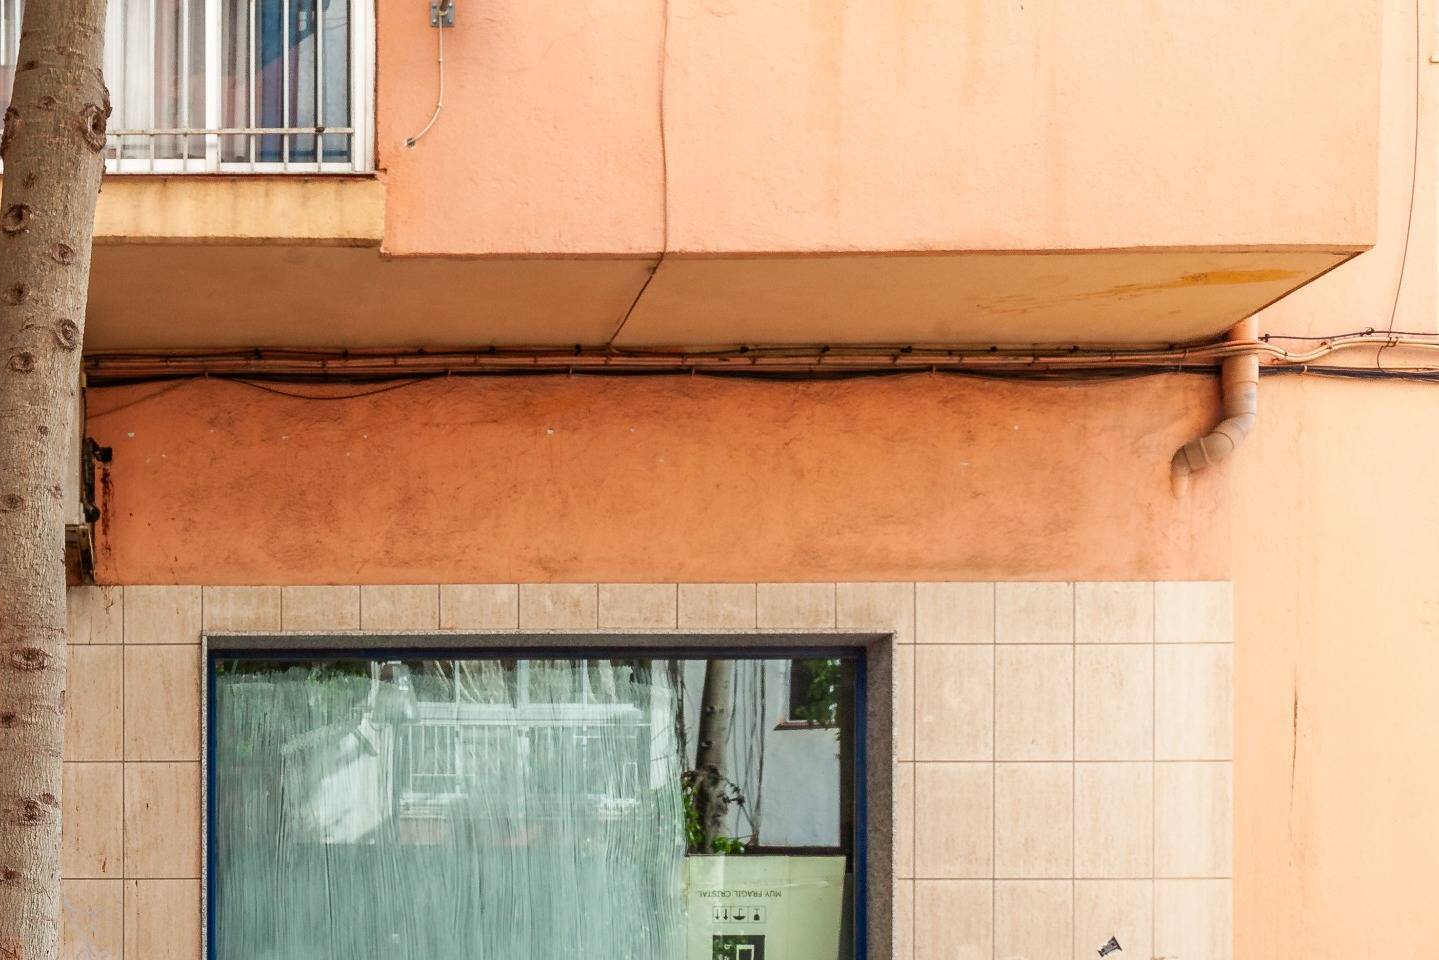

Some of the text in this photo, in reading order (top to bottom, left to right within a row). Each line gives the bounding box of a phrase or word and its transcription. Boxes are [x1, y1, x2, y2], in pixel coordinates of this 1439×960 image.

[697, 889, 782, 898] MUY FRAGIL CRISTAL
